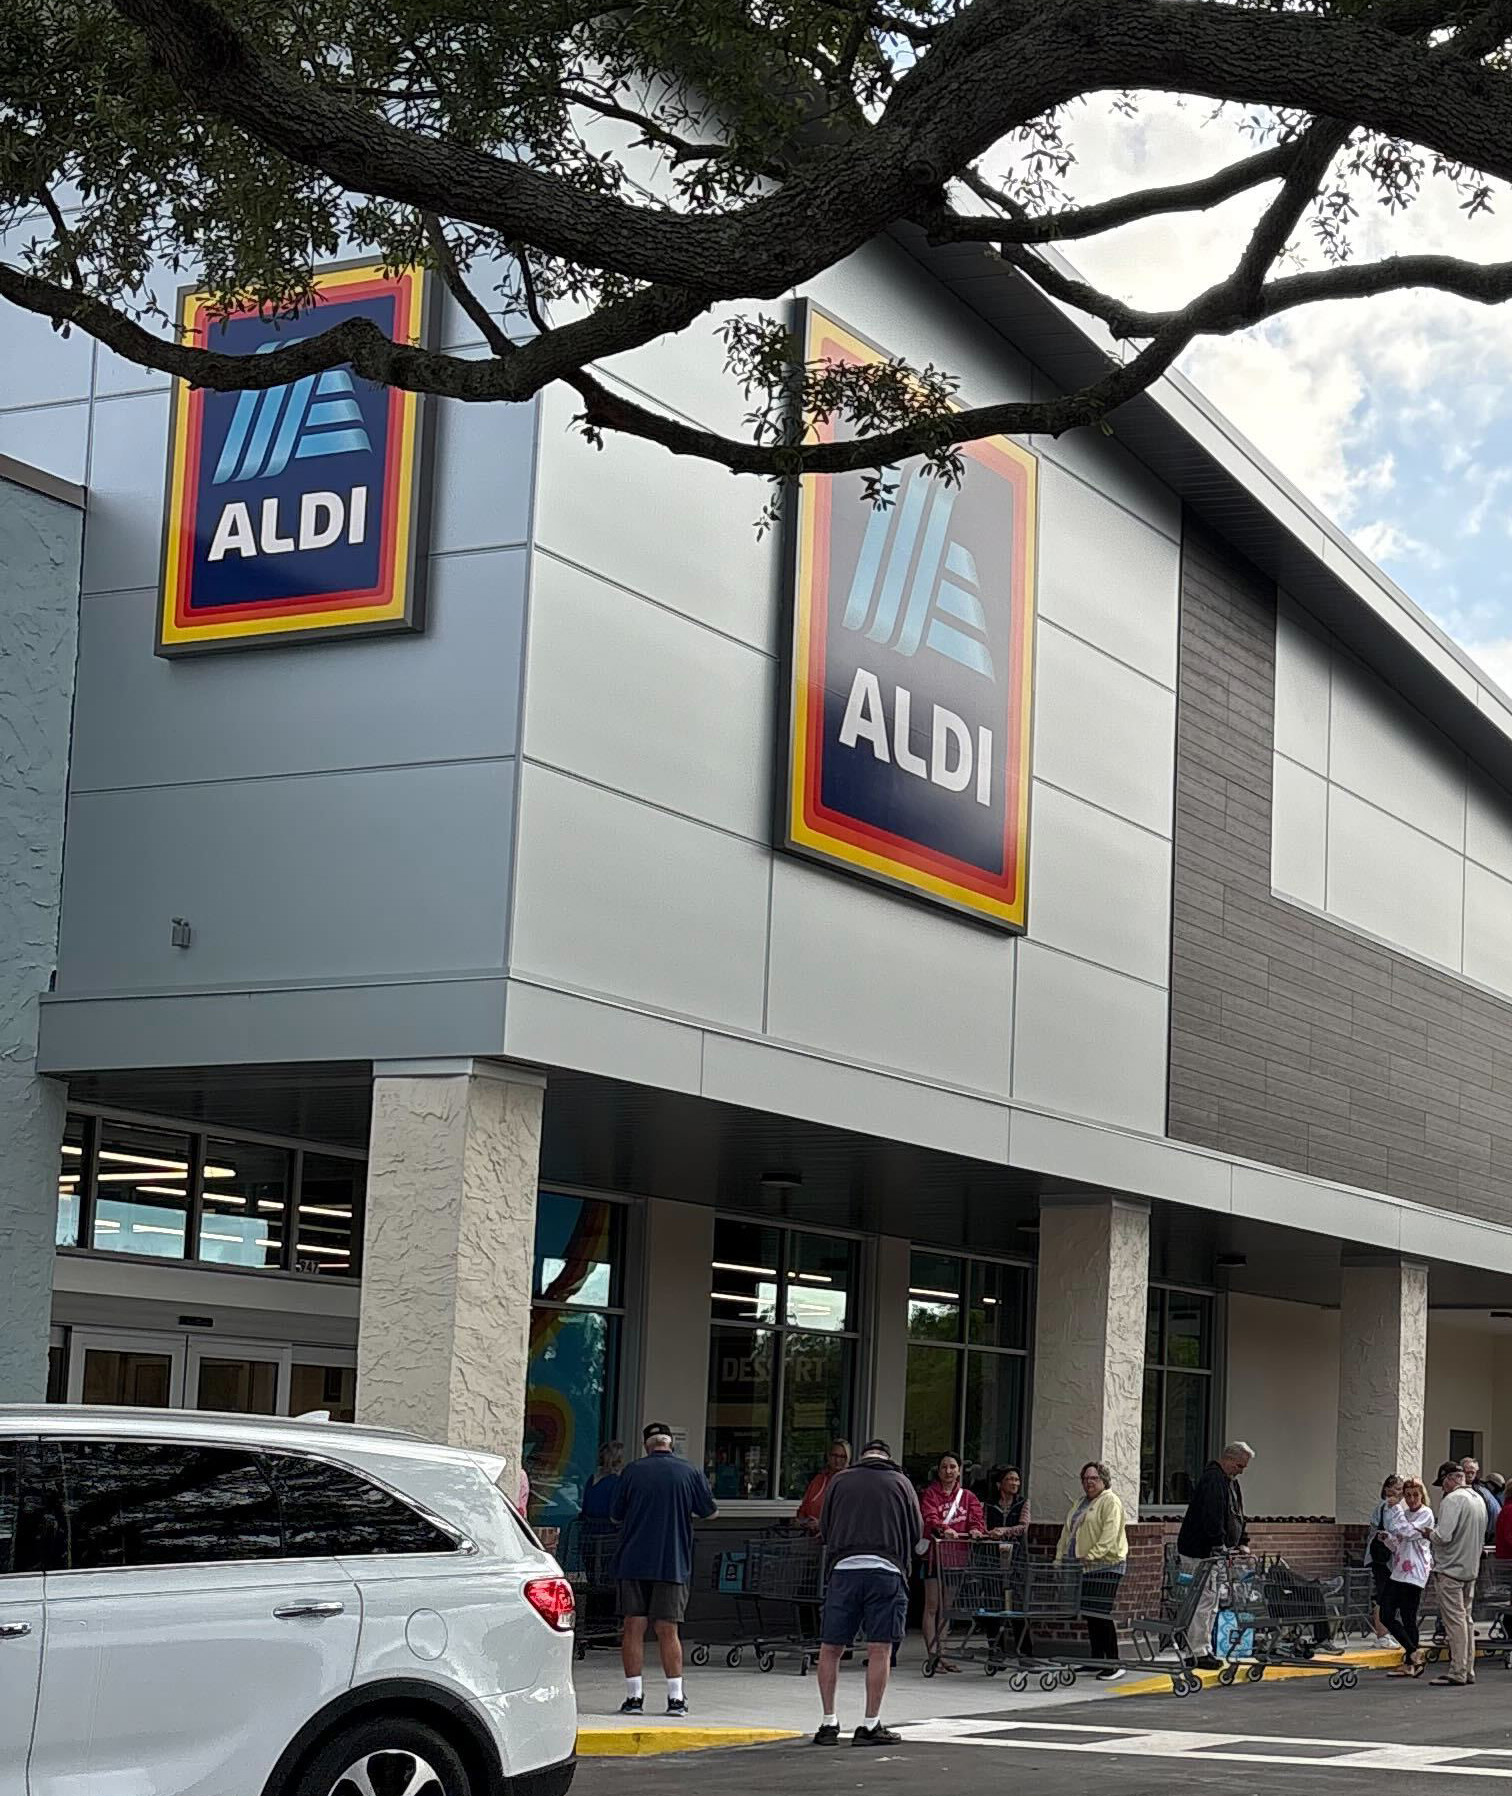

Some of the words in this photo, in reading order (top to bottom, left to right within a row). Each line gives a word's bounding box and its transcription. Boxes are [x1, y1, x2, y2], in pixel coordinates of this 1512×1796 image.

[207, 486, 367, 562] ALDI
[839, 667, 993, 807] ALDI
[721, 1356, 824, 1381] DESRT
